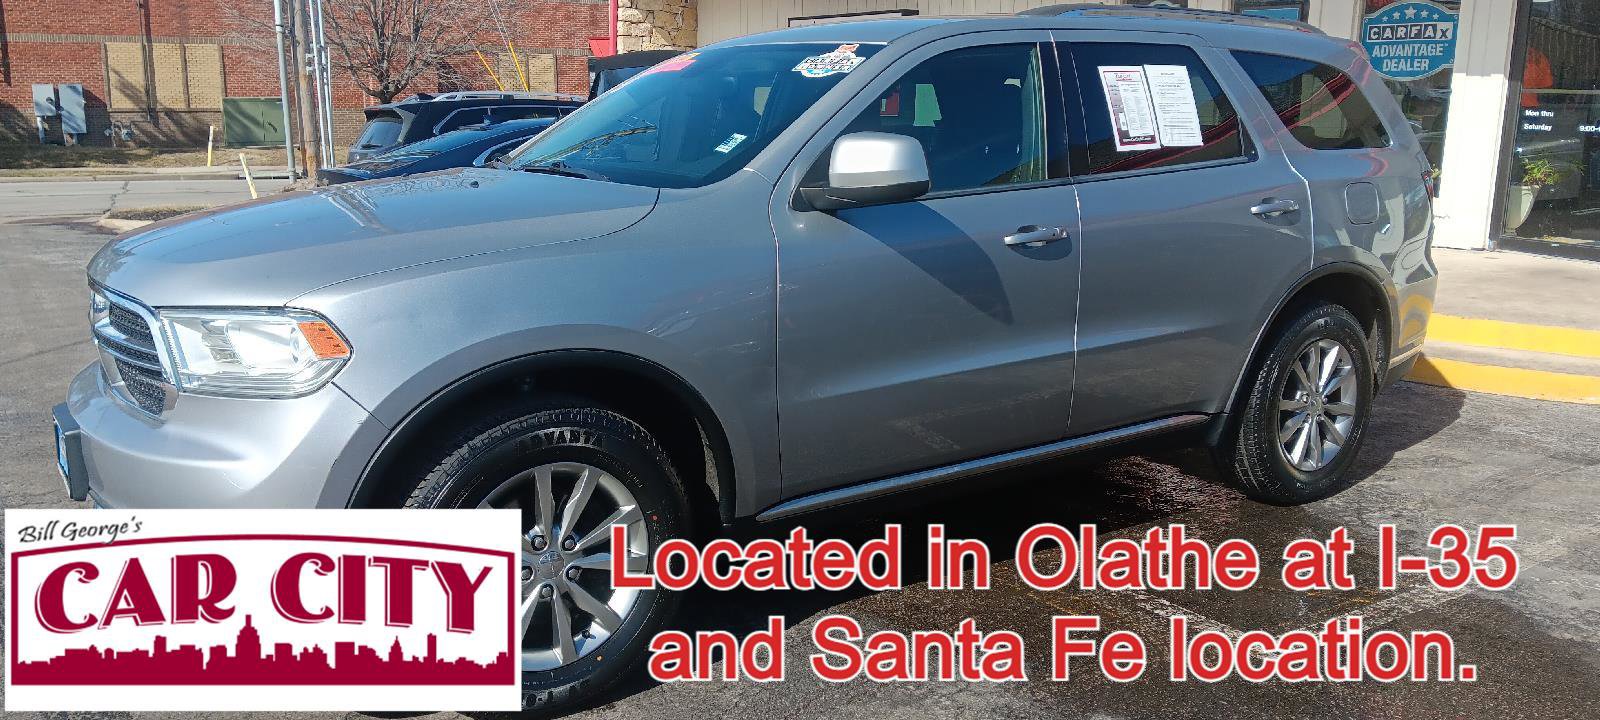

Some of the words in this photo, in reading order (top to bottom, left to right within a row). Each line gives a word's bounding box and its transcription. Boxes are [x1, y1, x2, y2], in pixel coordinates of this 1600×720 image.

[1368, 24, 1452, 40] CARFAX
[1372, 43, 1444, 57] ADVANTAGE
[1382, 58, 1430, 71] DEALER
[1523, 123, 1552, 131] Saturday
